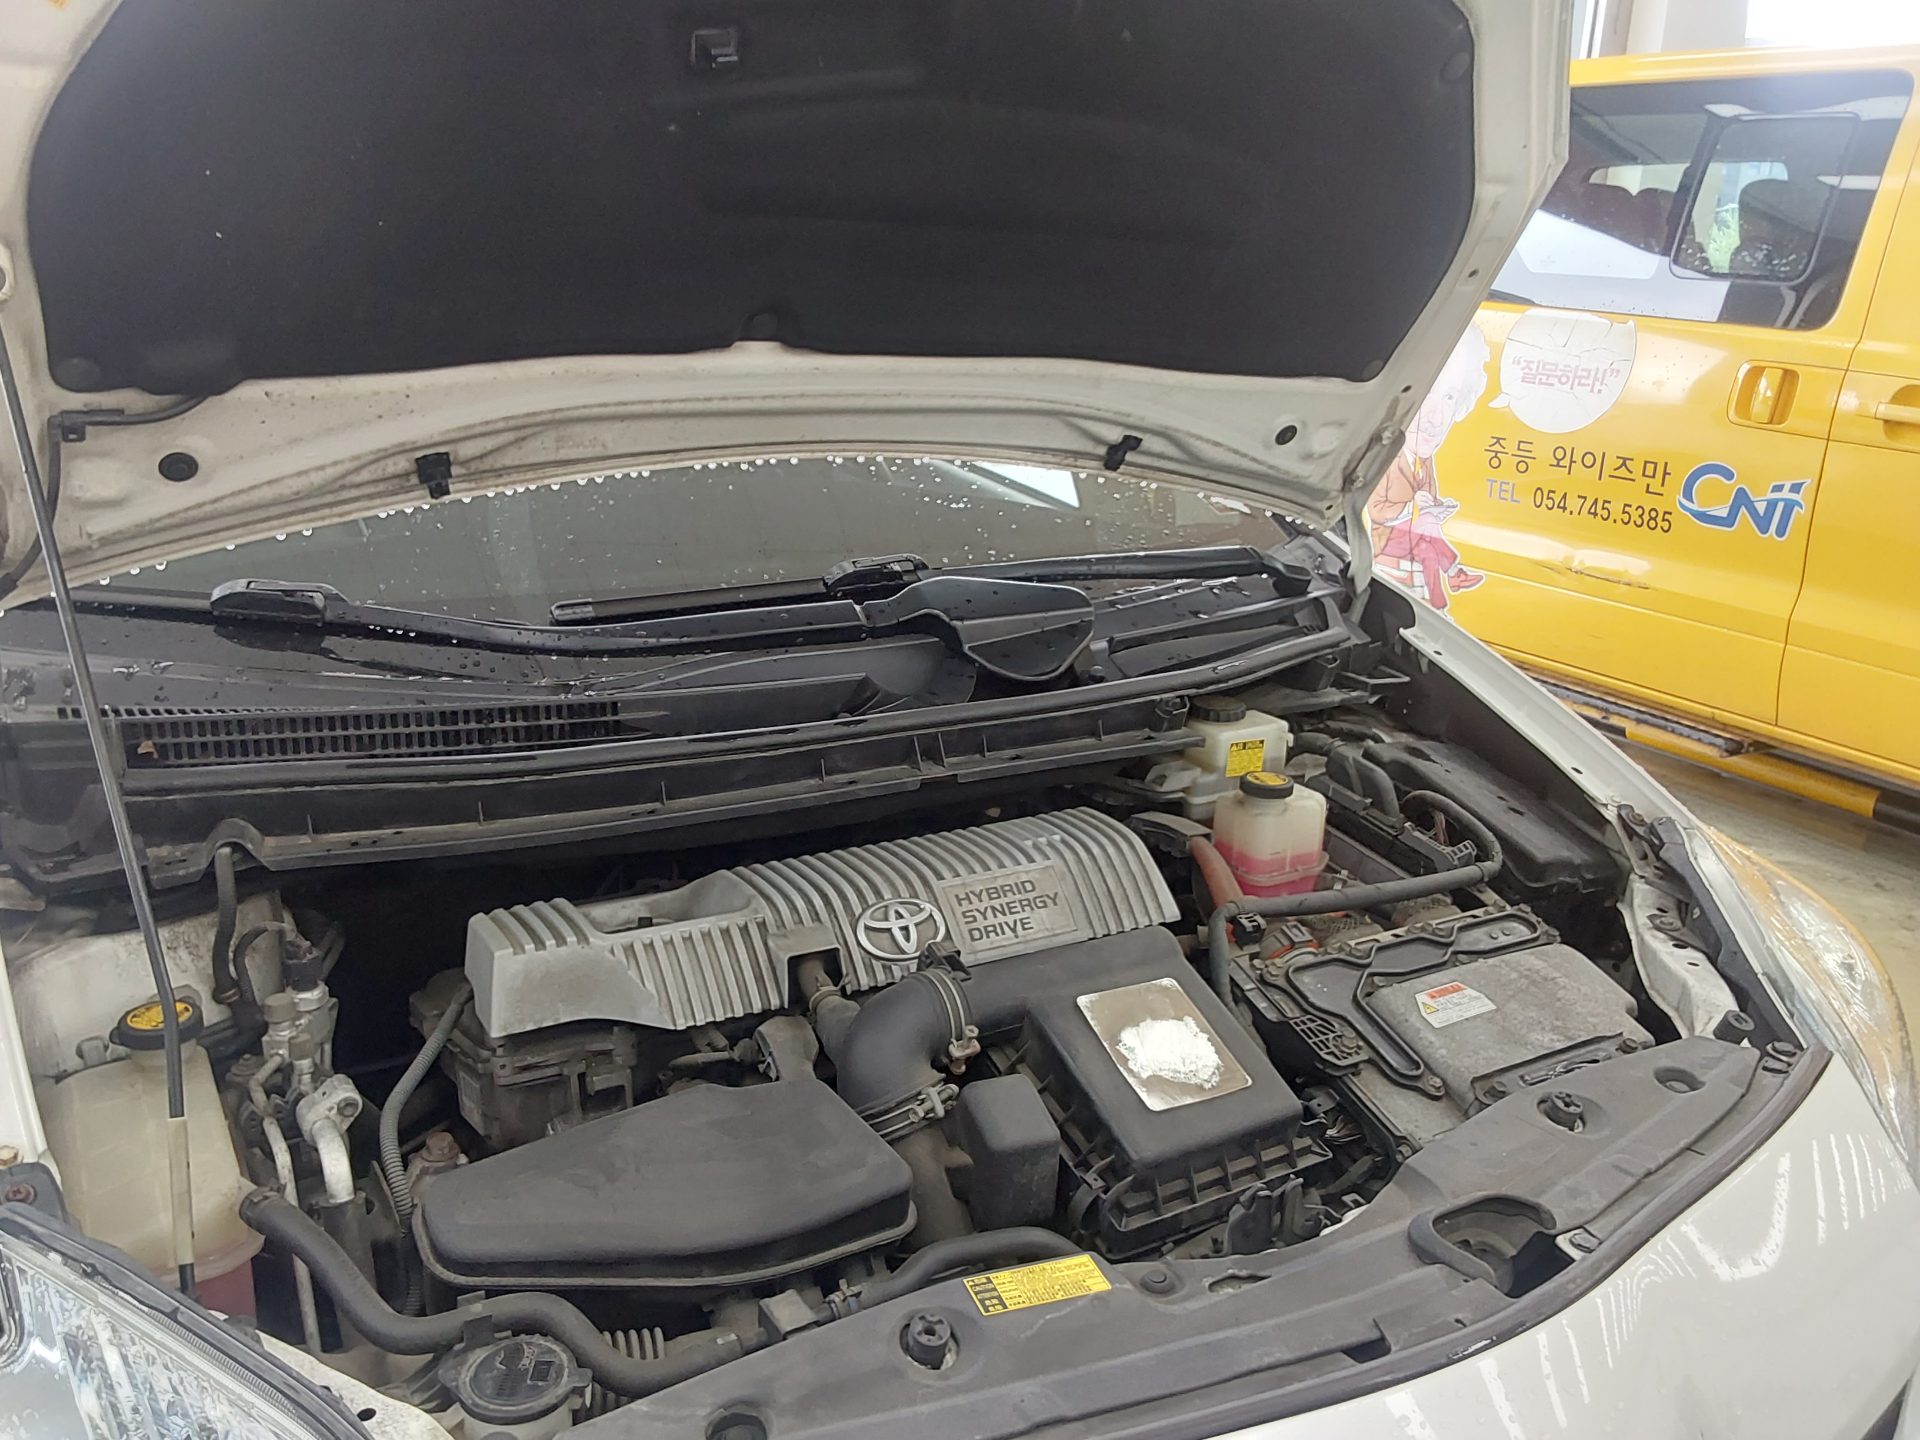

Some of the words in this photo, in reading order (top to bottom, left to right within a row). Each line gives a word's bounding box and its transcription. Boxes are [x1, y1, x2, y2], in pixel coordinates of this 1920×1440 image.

[1484, 436, 1537, 474] 중등
[1549, 446, 1672, 497] 와이즈만
[1486, 478, 1521, 504] TEL
[1533, 487, 1673, 533] 054.745.5385
[954, 880, 1036, 907] HYBRID
[961, 892, 1059, 925] SYNERGY
[968, 916, 1034, 942] DRIVE
